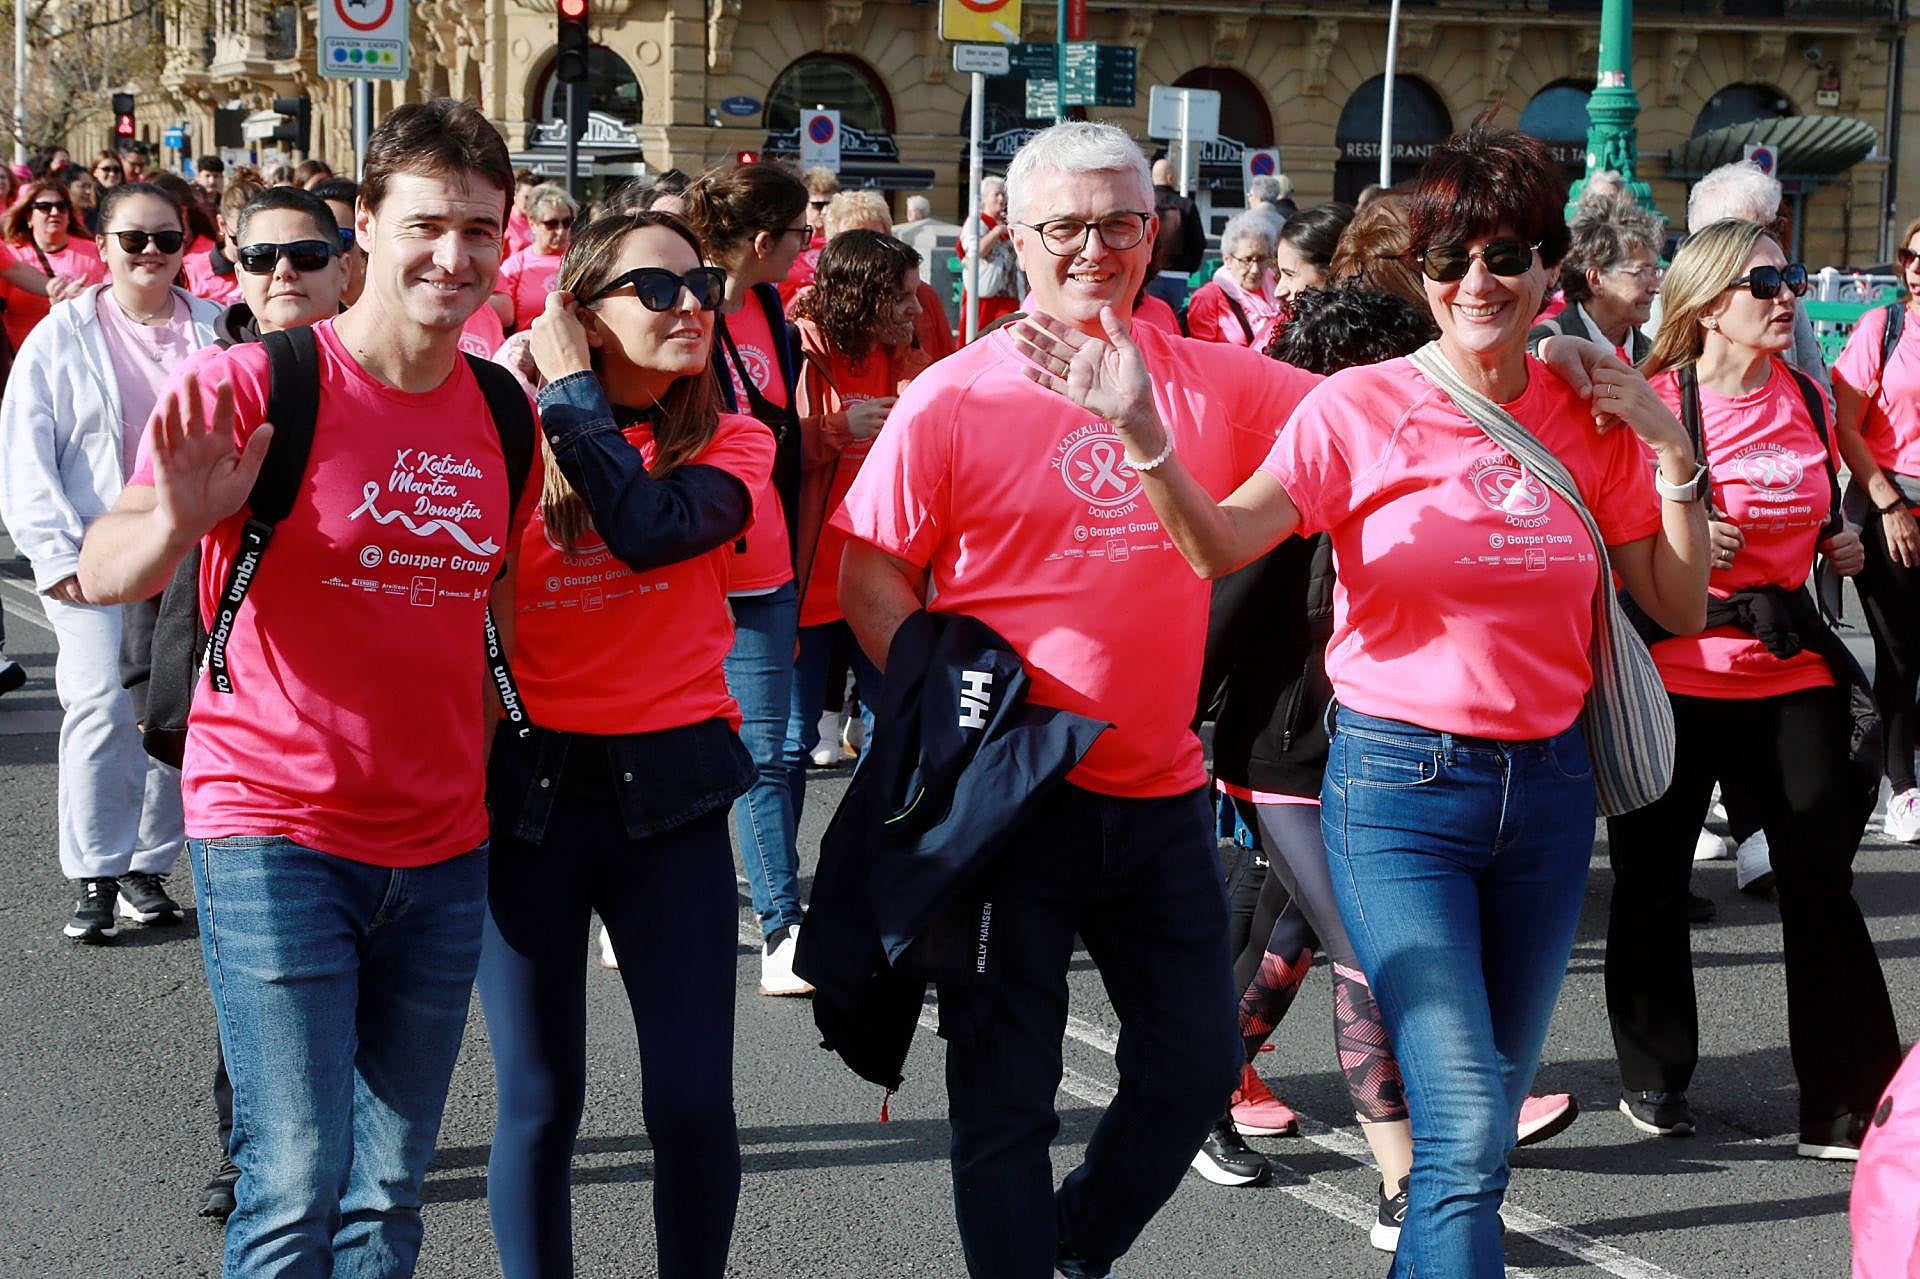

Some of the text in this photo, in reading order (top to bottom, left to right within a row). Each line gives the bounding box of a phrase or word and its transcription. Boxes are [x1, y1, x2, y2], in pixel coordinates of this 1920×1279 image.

[1056, 423, 1108, 453] KATXALIN
[417, 451, 483, 480] Katxalin
[388, 469, 458, 498] Martxa
[413, 495, 482, 523] Donostia
[1088, 501, 1138, 519] DONOSTIA
[1128, 522, 1159, 533] Group
[1546, 534, 1573, 545] Group
[388, 549, 447, 570] Goizper
[450, 555, 490, 576] Group
[213, 609, 232, 668] umbro
[494, 666, 522, 722] umbro
[977, 902, 993, 973] HELLY HANSEN
